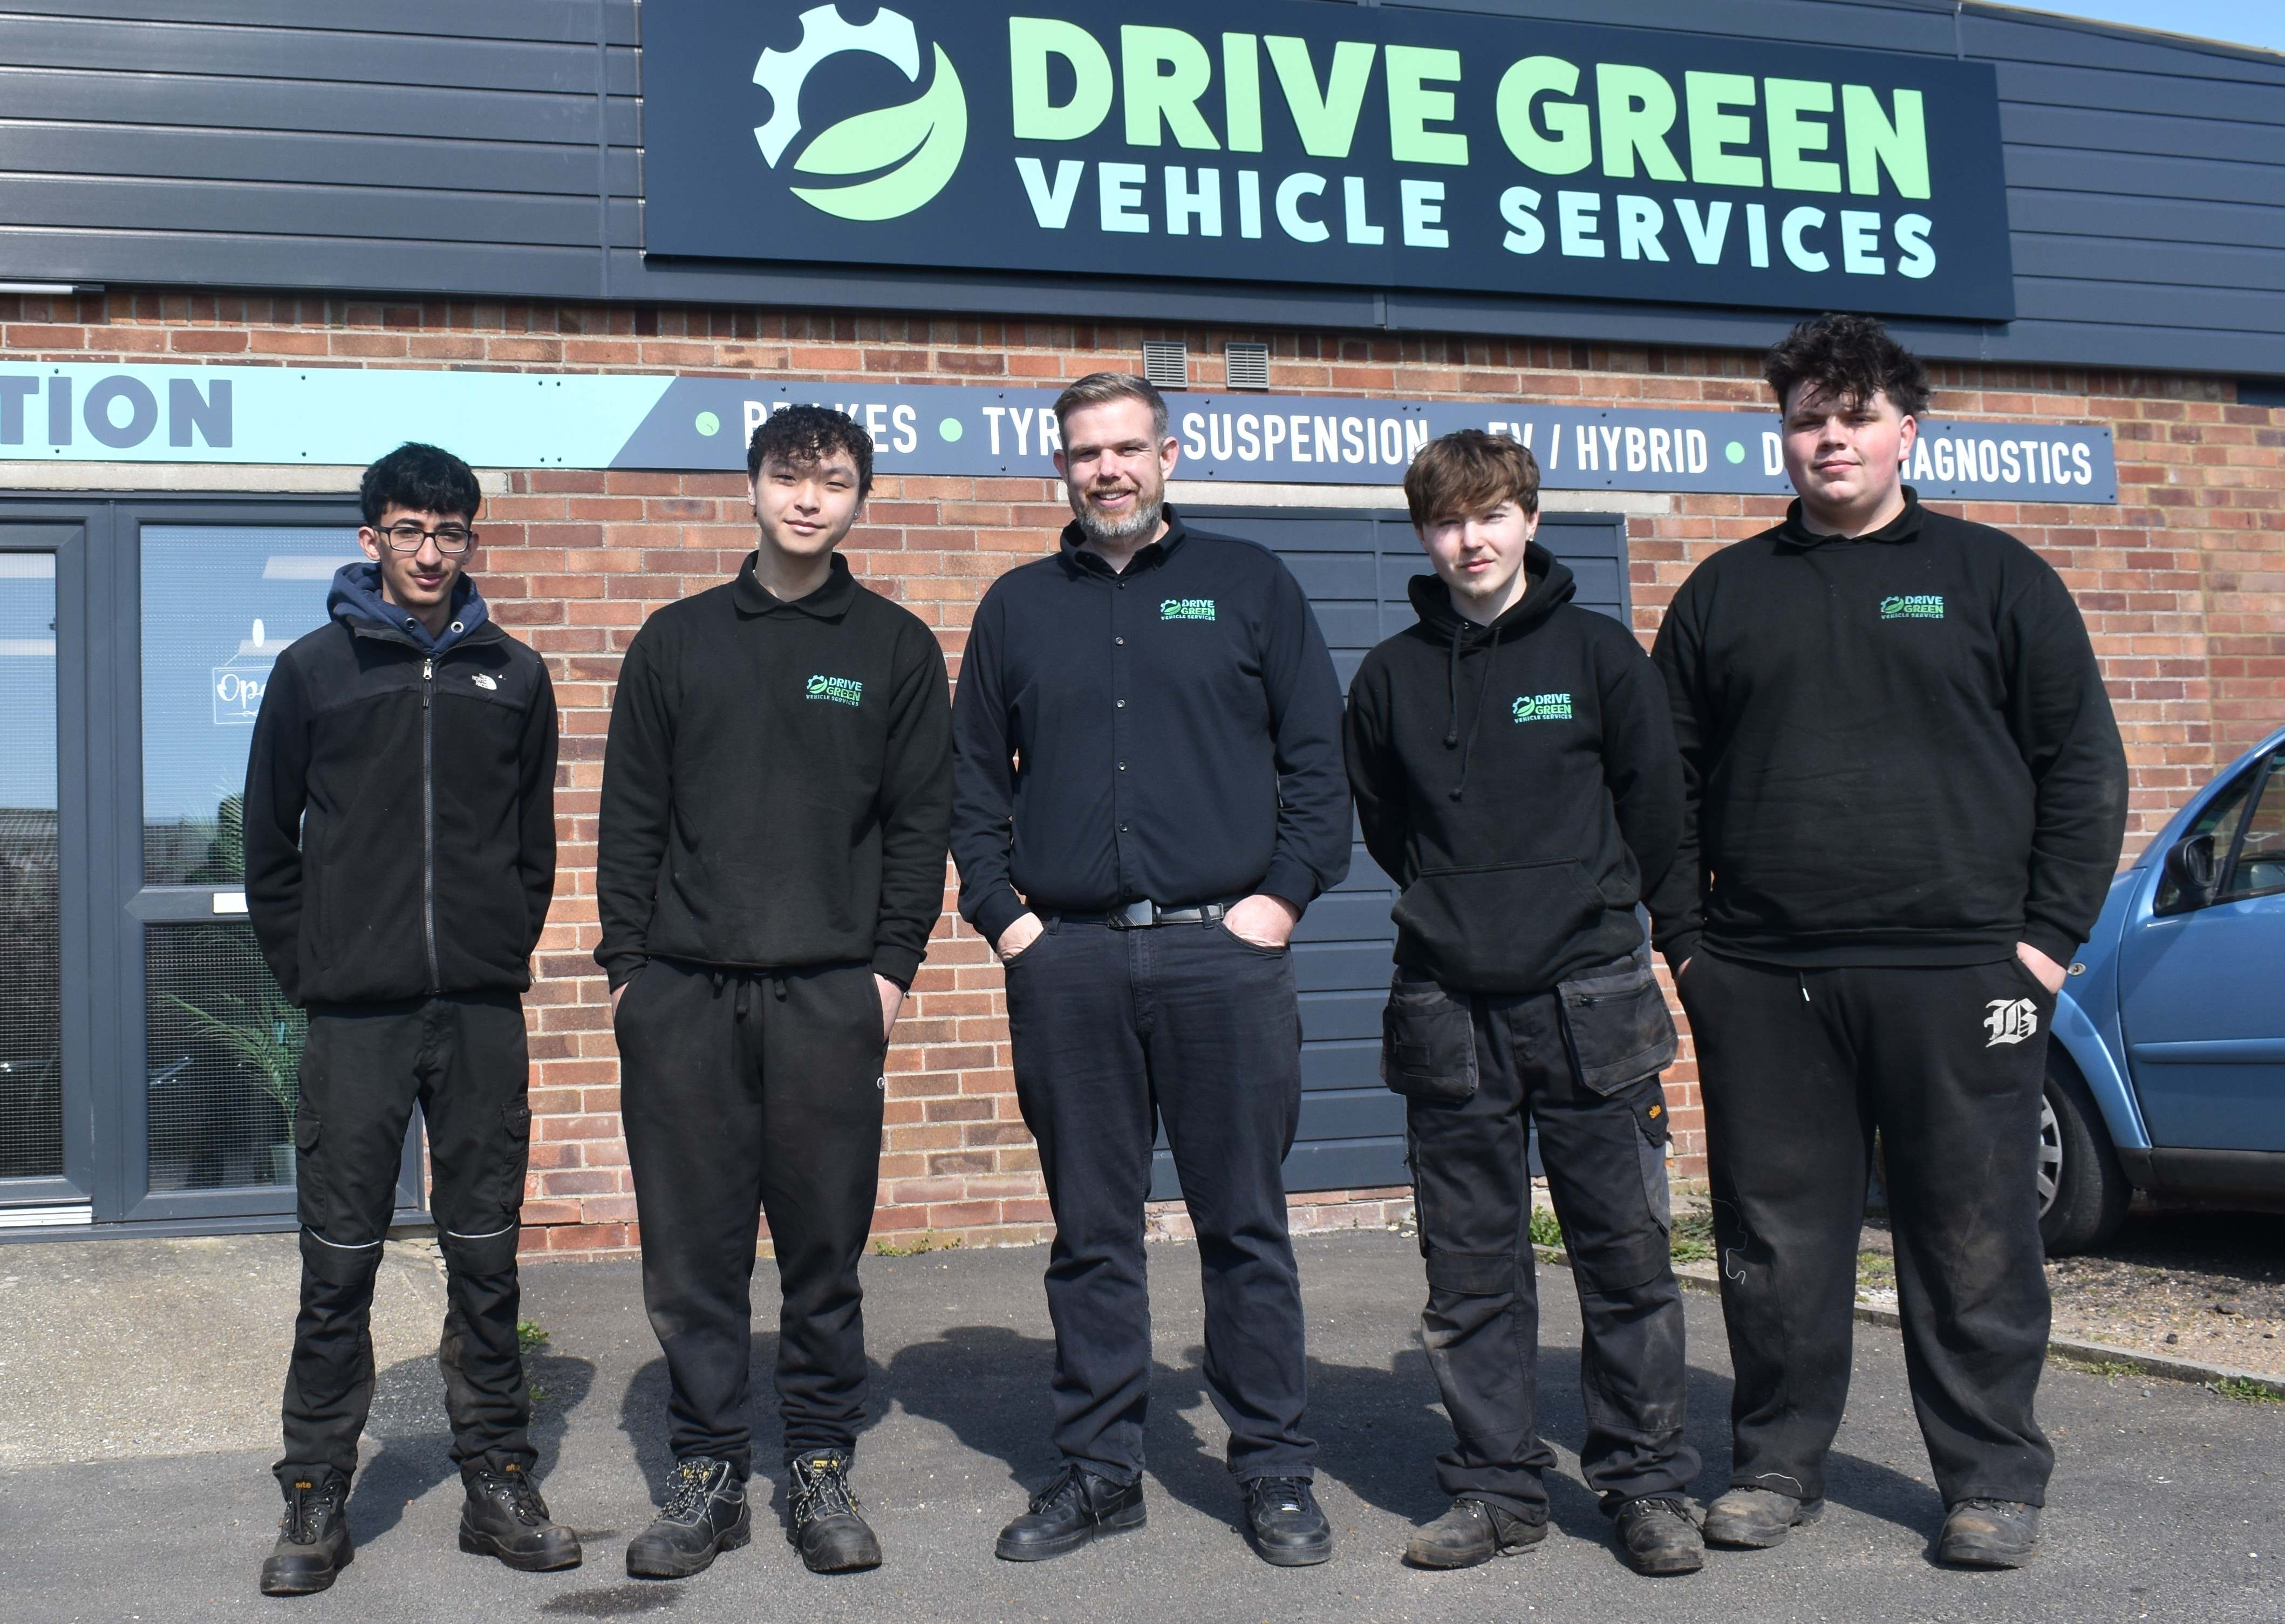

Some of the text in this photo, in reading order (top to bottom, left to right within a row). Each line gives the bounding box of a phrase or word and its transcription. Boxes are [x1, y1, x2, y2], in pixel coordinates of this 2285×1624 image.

[1010, 17, 1931, 200] DRIVE GREEN
[1015, 158, 1936, 278] VEHICLE SERVICES
[744, 400, 917, 453] BES
[983, 407, 1063, 456] TYR
[1182, 412, 1429, 466] SUSPENSION
[1577, 425, 1707, 473] HYBRID
[1901, 438, 2092, 485] AGNOSTICS
[1182, 599, 1215, 608] DRIVE
[1905, 595, 1943, 605] DRIVE
[1181, 607, 1215, 616] GREEN
[1904, 604, 1943, 613] GREEN
[829, 677, 863, 691] DRIVE
[217, 673, 267, 709] Op
[826, 686, 861, 701] GREEN
[831, 694, 859, 707] SERVICES
[1535, 693, 1571, 705] DRIVE
[1534, 704, 1571, 714] GREEN
[1514, 715, 1541, 724] VEHICLE
